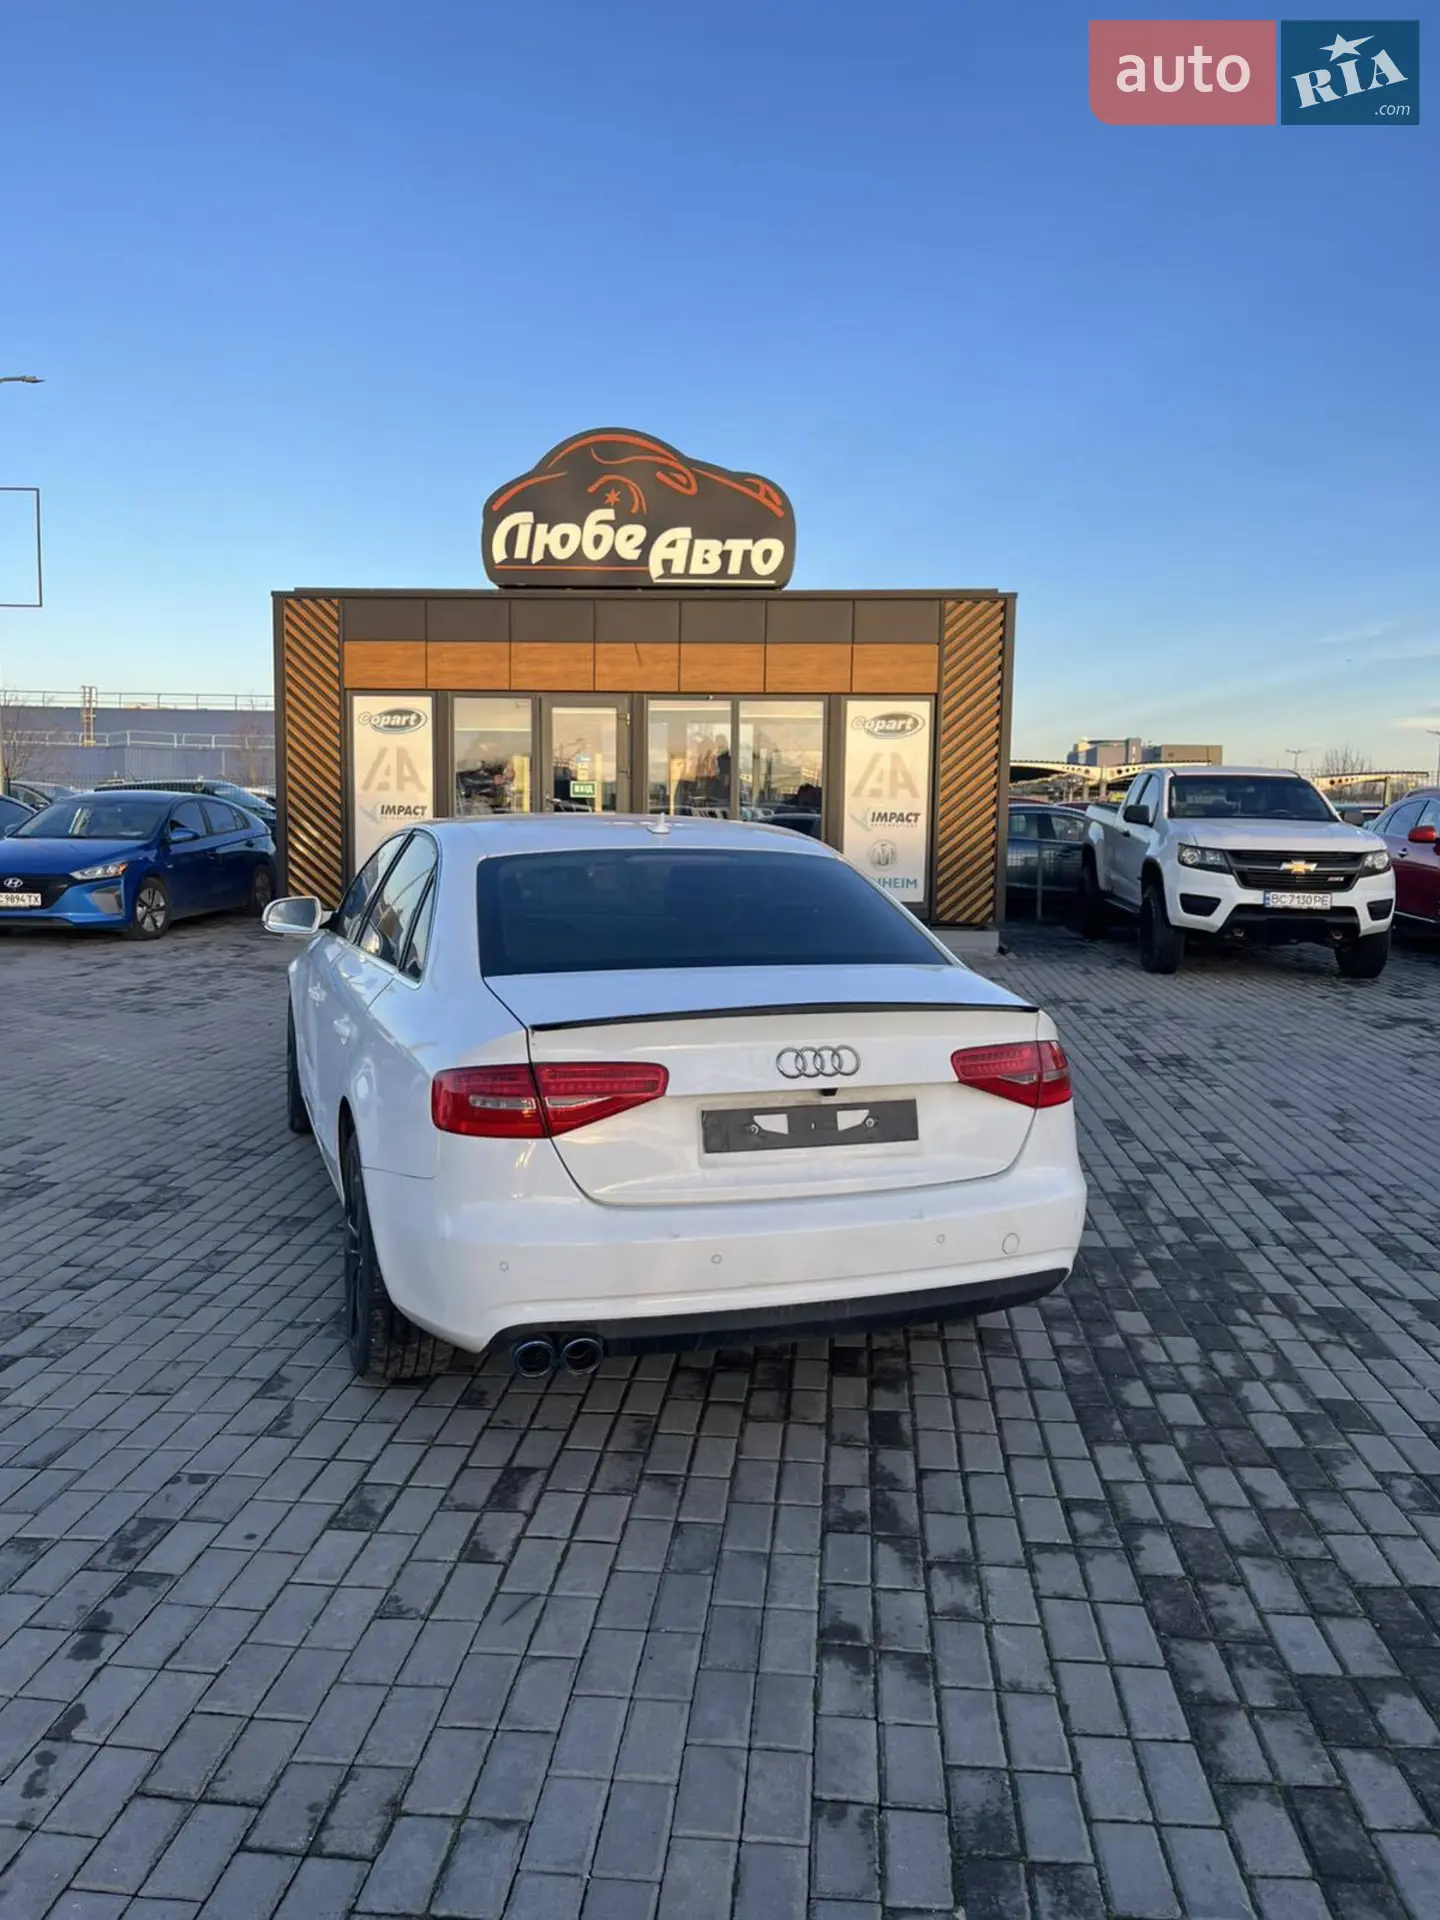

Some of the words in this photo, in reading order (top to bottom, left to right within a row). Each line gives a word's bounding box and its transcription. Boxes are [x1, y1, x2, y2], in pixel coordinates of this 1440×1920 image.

[492, 508, 647, 564] Любе
[648, 527, 785, 582] Авто
[380, 804, 428, 816] IMPACT
[871, 811, 921, 824] IMPACT
[877, 877, 918, 889] HEIM
